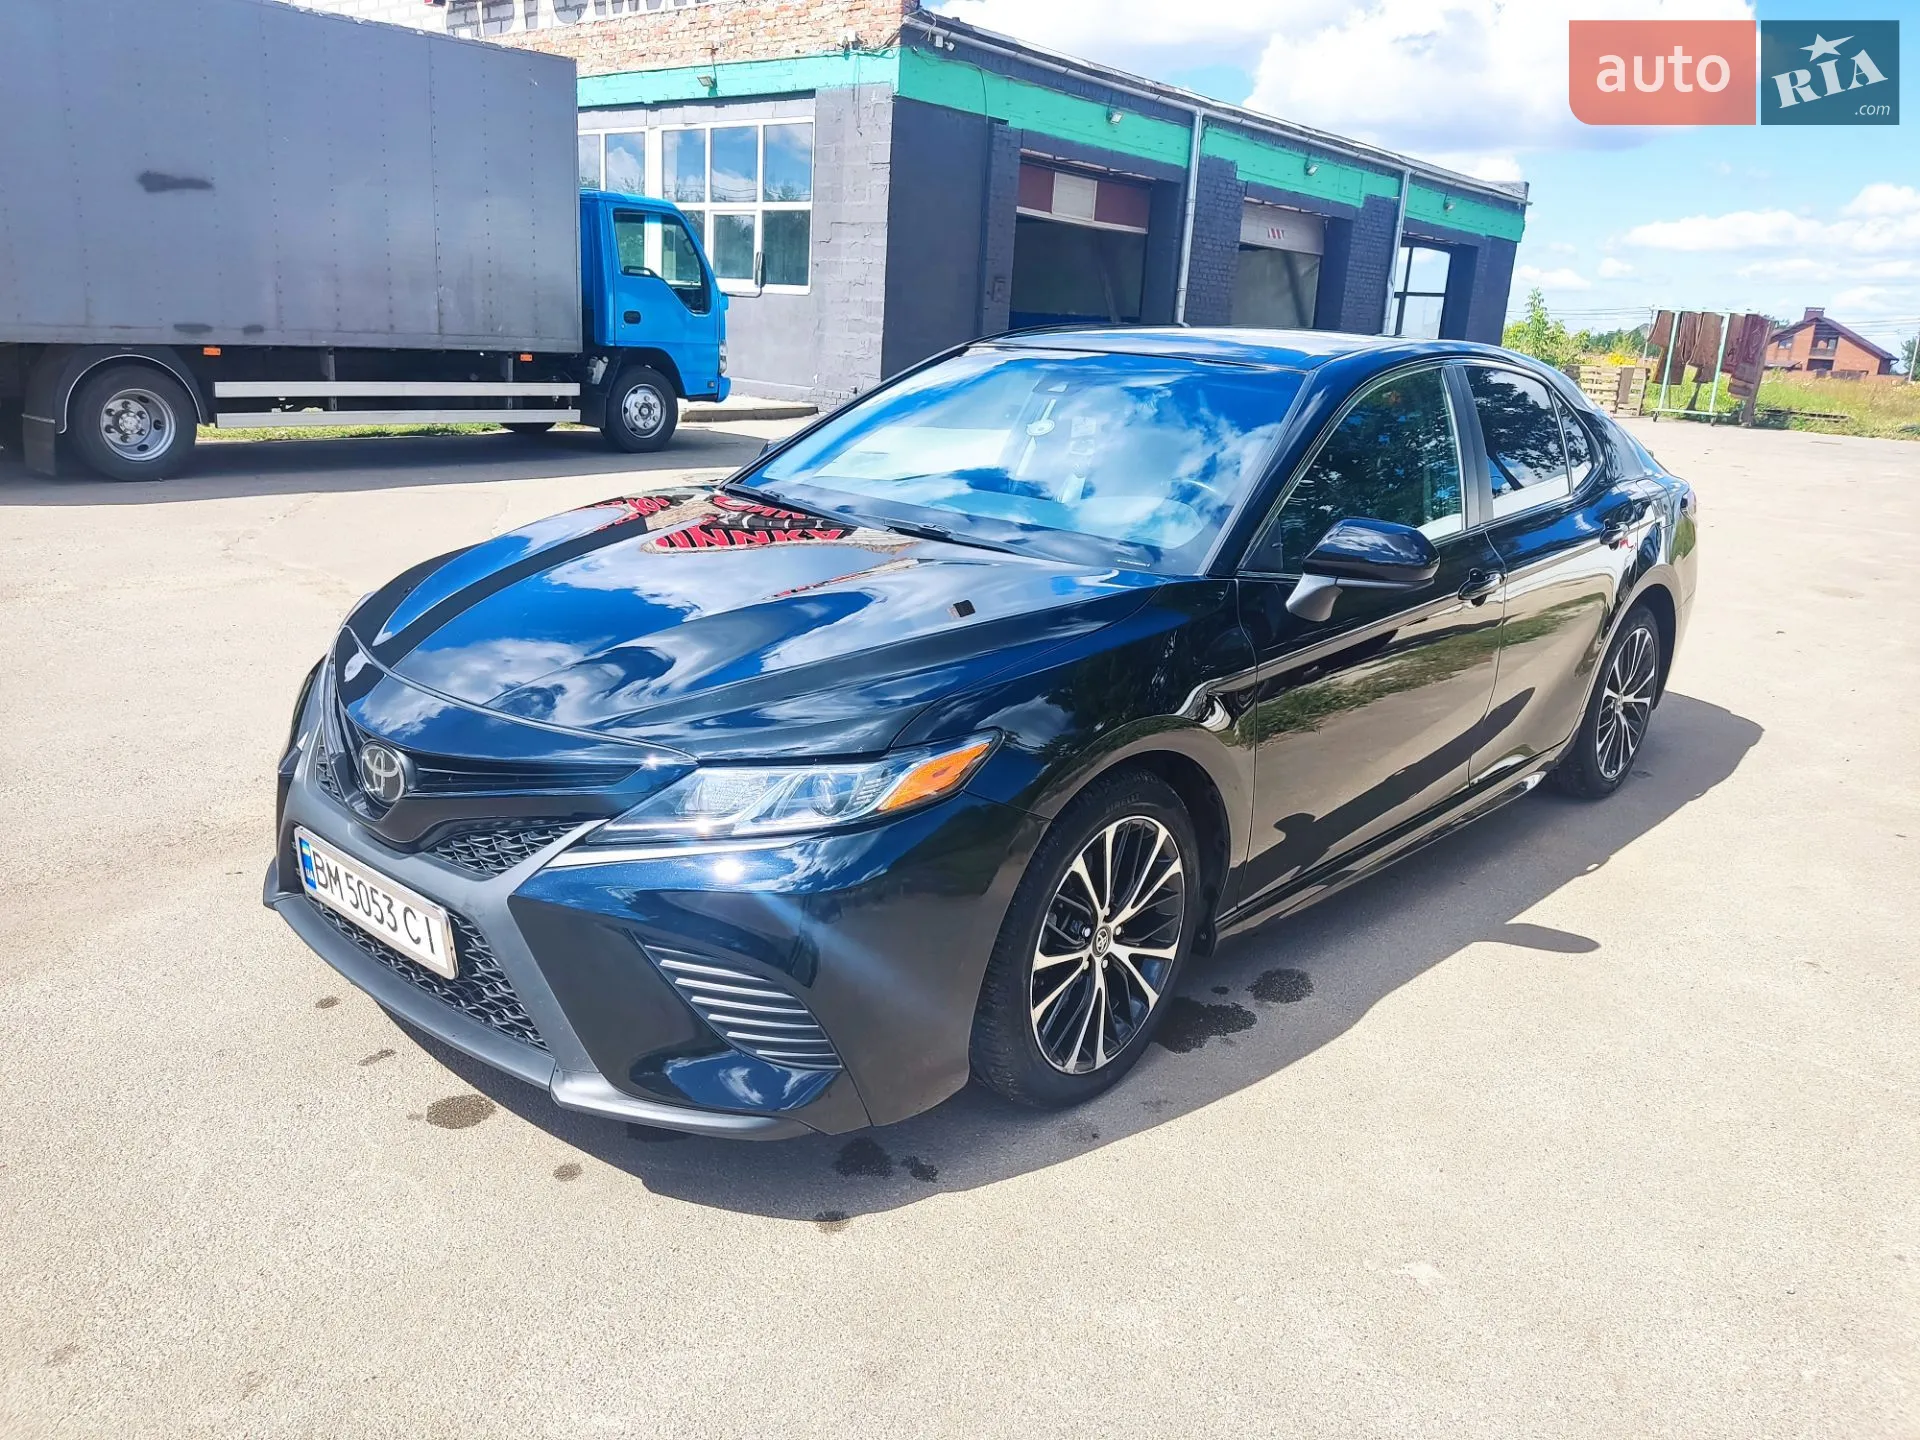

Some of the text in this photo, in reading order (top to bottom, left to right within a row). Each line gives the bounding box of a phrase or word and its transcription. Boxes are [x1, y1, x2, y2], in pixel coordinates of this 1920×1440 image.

[312, 849, 435, 955] BM 5053 CI
